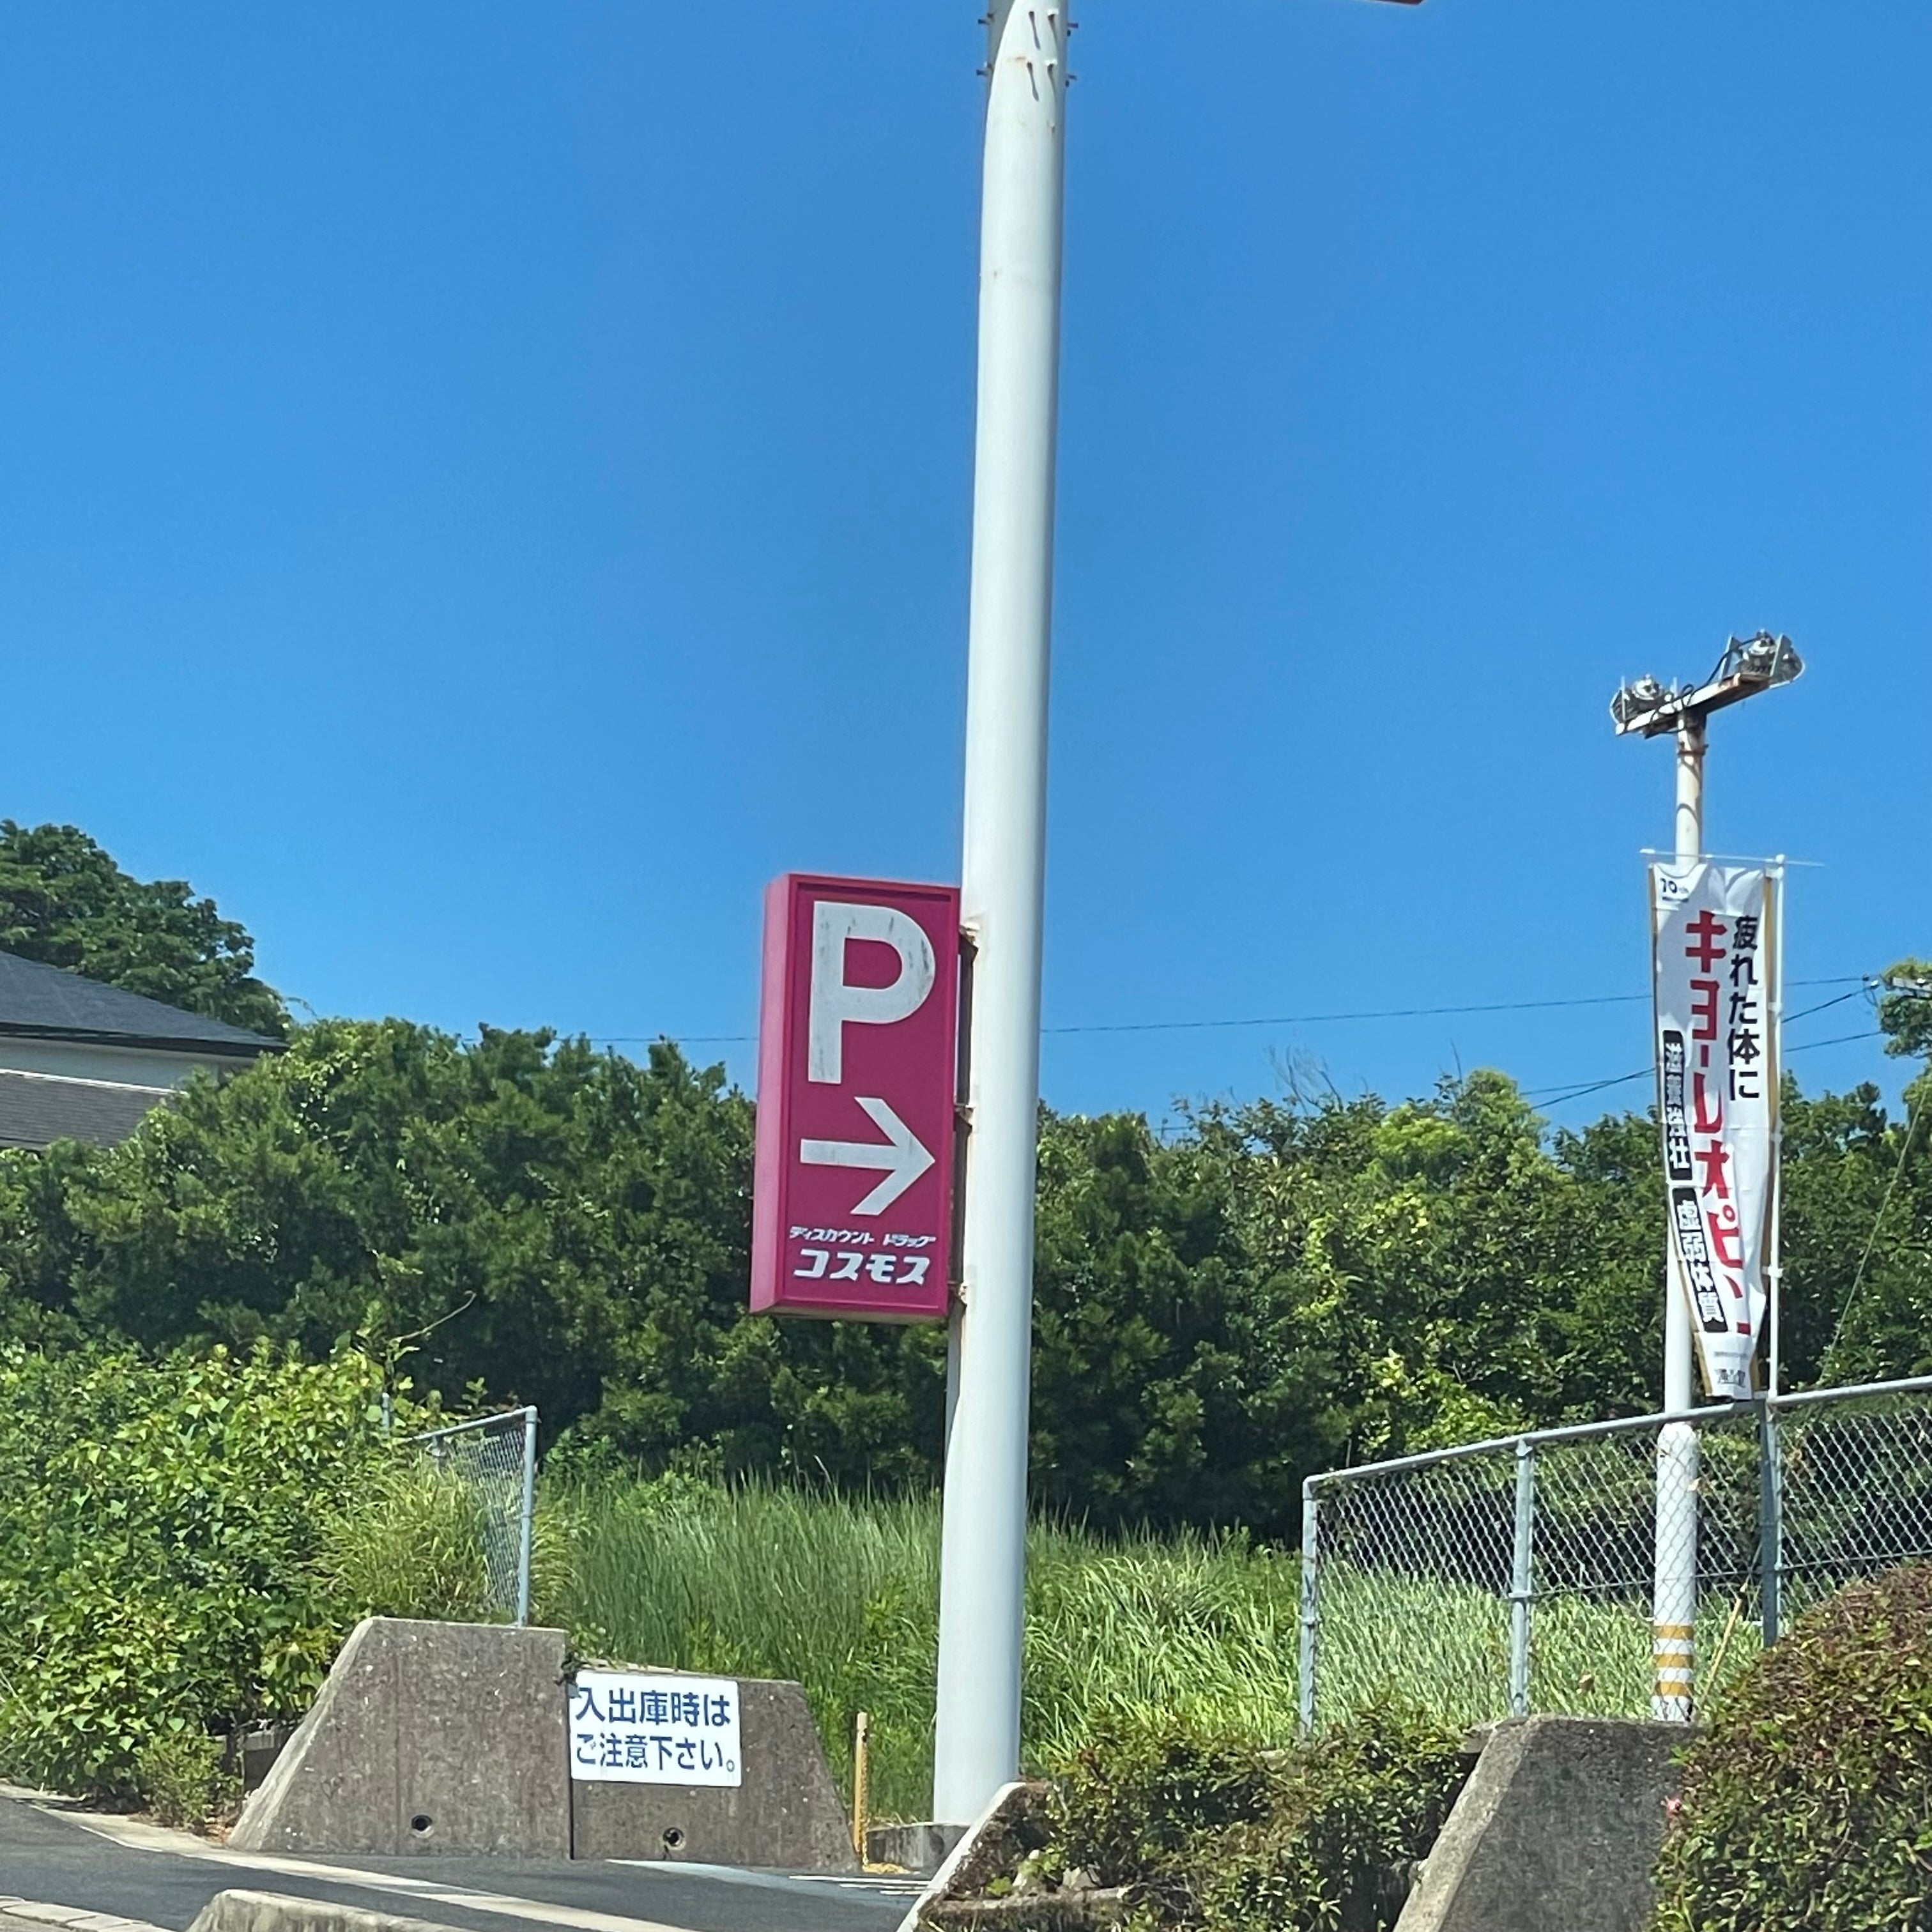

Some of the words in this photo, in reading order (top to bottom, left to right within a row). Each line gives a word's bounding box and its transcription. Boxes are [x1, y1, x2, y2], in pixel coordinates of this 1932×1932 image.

[808, 900, 935, 1084] P
[1728, 915, 1760, 1101] 疲れた体に
[790, 1225, 875, 1245] ディスカウント
[883, 1233, 936, 1248] ドラッグ
[793, 1248, 930, 1286] コスモス
[576, 1687, 731, 1727] 入出庫時は
[576, 1732, 735, 1772] ご注意下さい。
